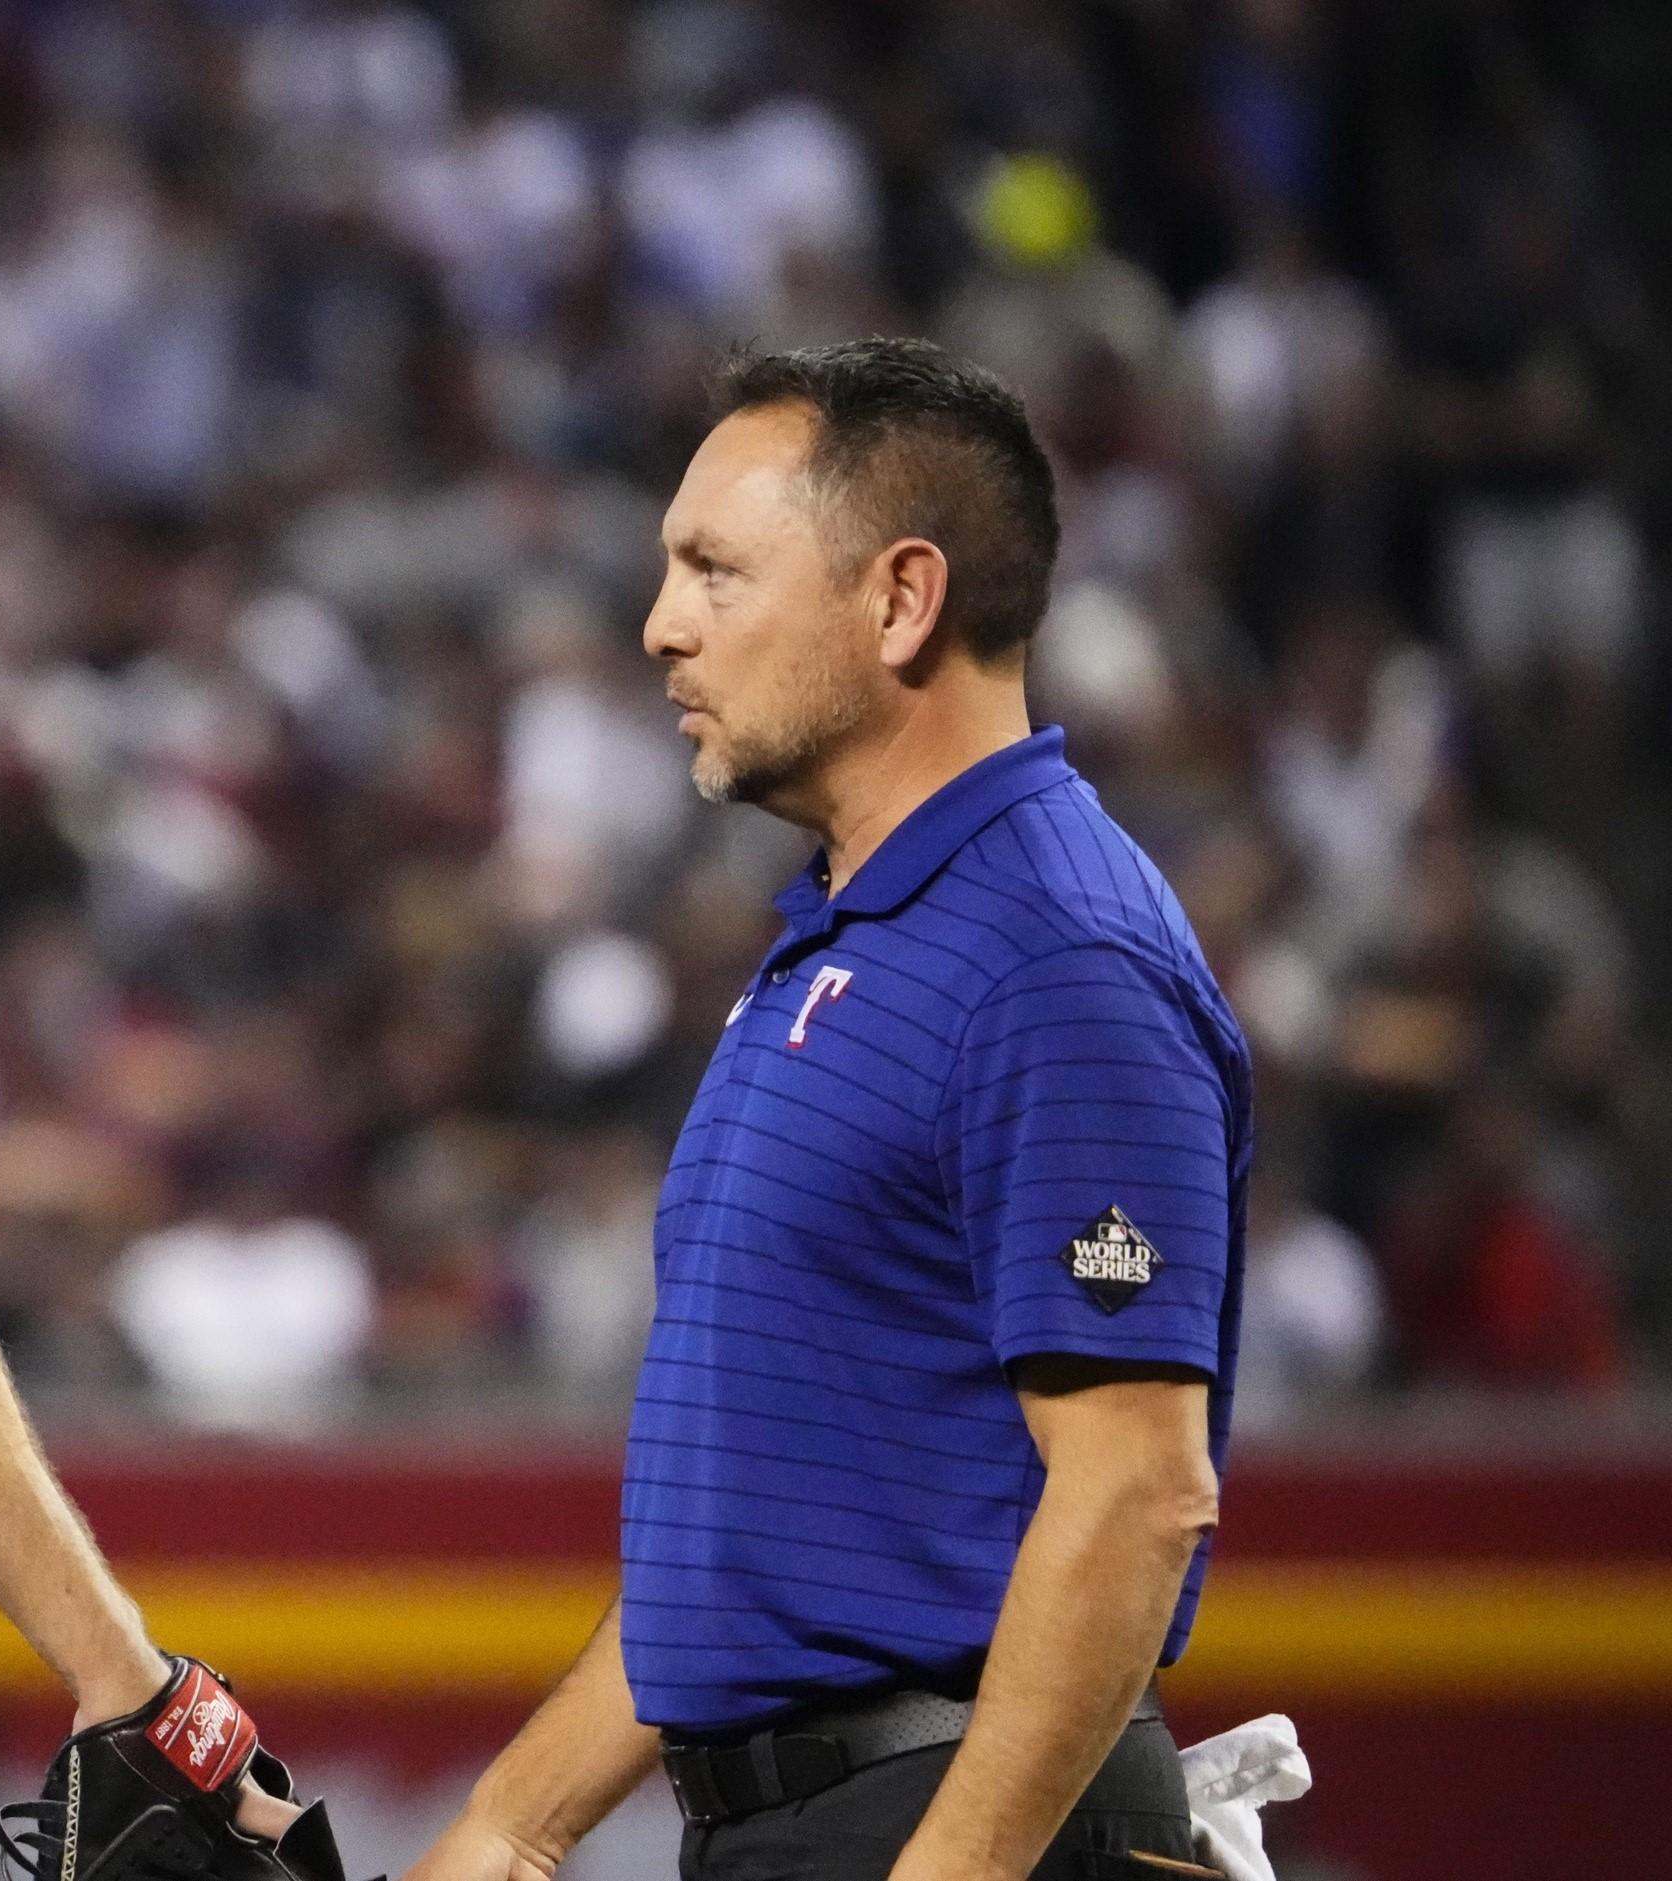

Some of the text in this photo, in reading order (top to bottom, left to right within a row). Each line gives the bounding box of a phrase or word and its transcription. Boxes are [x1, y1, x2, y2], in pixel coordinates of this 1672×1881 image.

[786, 965, 854, 1049] T
[1072, 1239, 1151, 1264] WORLD
[1072, 1257, 1151, 1284] SERIES
[187, 1689, 236, 1768] Rawlings
